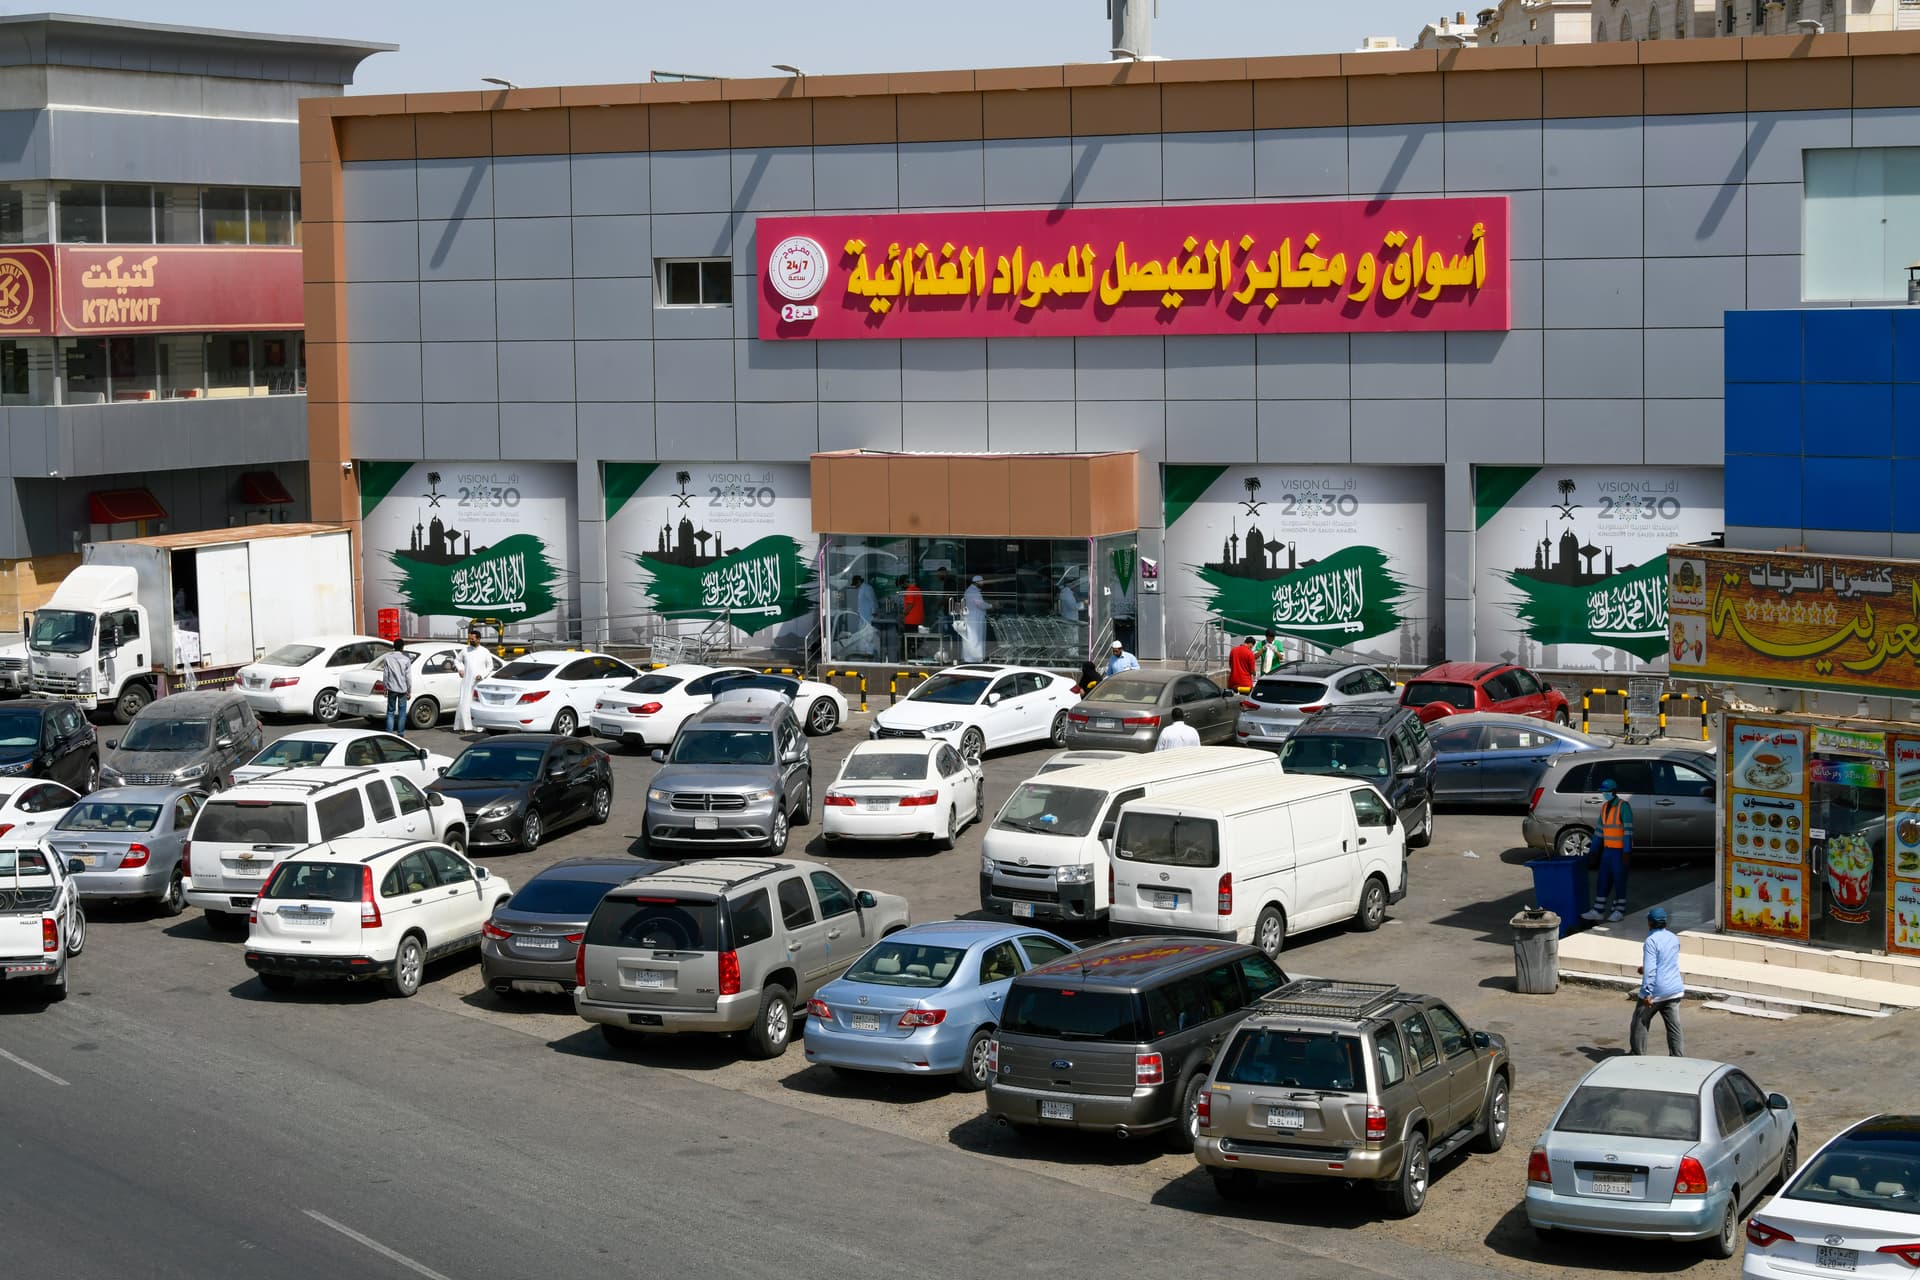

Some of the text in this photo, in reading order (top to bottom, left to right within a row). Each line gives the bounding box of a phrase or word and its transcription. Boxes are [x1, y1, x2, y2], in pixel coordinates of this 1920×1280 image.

[782, 244, 811, 260] مفتوح
[81, 256, 158, 294] كتيكت
[844, 222, 1486, 314] أسواق و مخابز الفيصل للمواد الغذائية
[82, 298, 160, 323] KTAYKIT
[785, 307, 793, 319] 2
[458, 474, 489, 483] VISION
[708, 473, 741, 482] VISION
[1281, 480, 1320, 490] VISION
[1598, 482, 1640, 492] VISION
[1750, 561, 1824, 596] القريات
